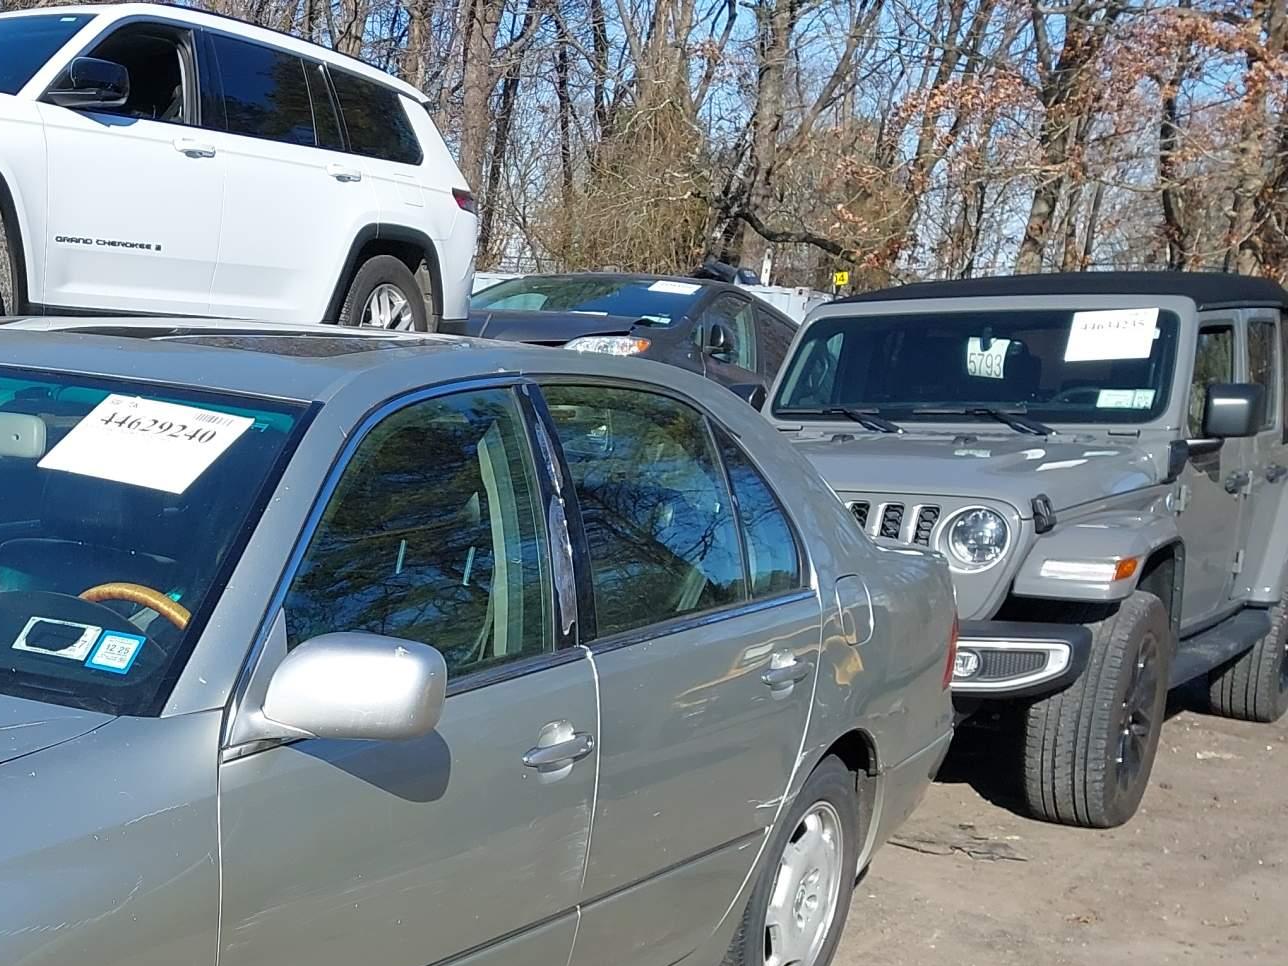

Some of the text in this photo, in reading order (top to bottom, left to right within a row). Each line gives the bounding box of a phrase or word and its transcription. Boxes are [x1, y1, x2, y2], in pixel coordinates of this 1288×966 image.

[55, 235, 93, 245] GRAND
[95, 239, 152, 250] CHEROKEE
[968, 353, 1002, 377] 5793
[100, 412, 218, 444] 44629240
